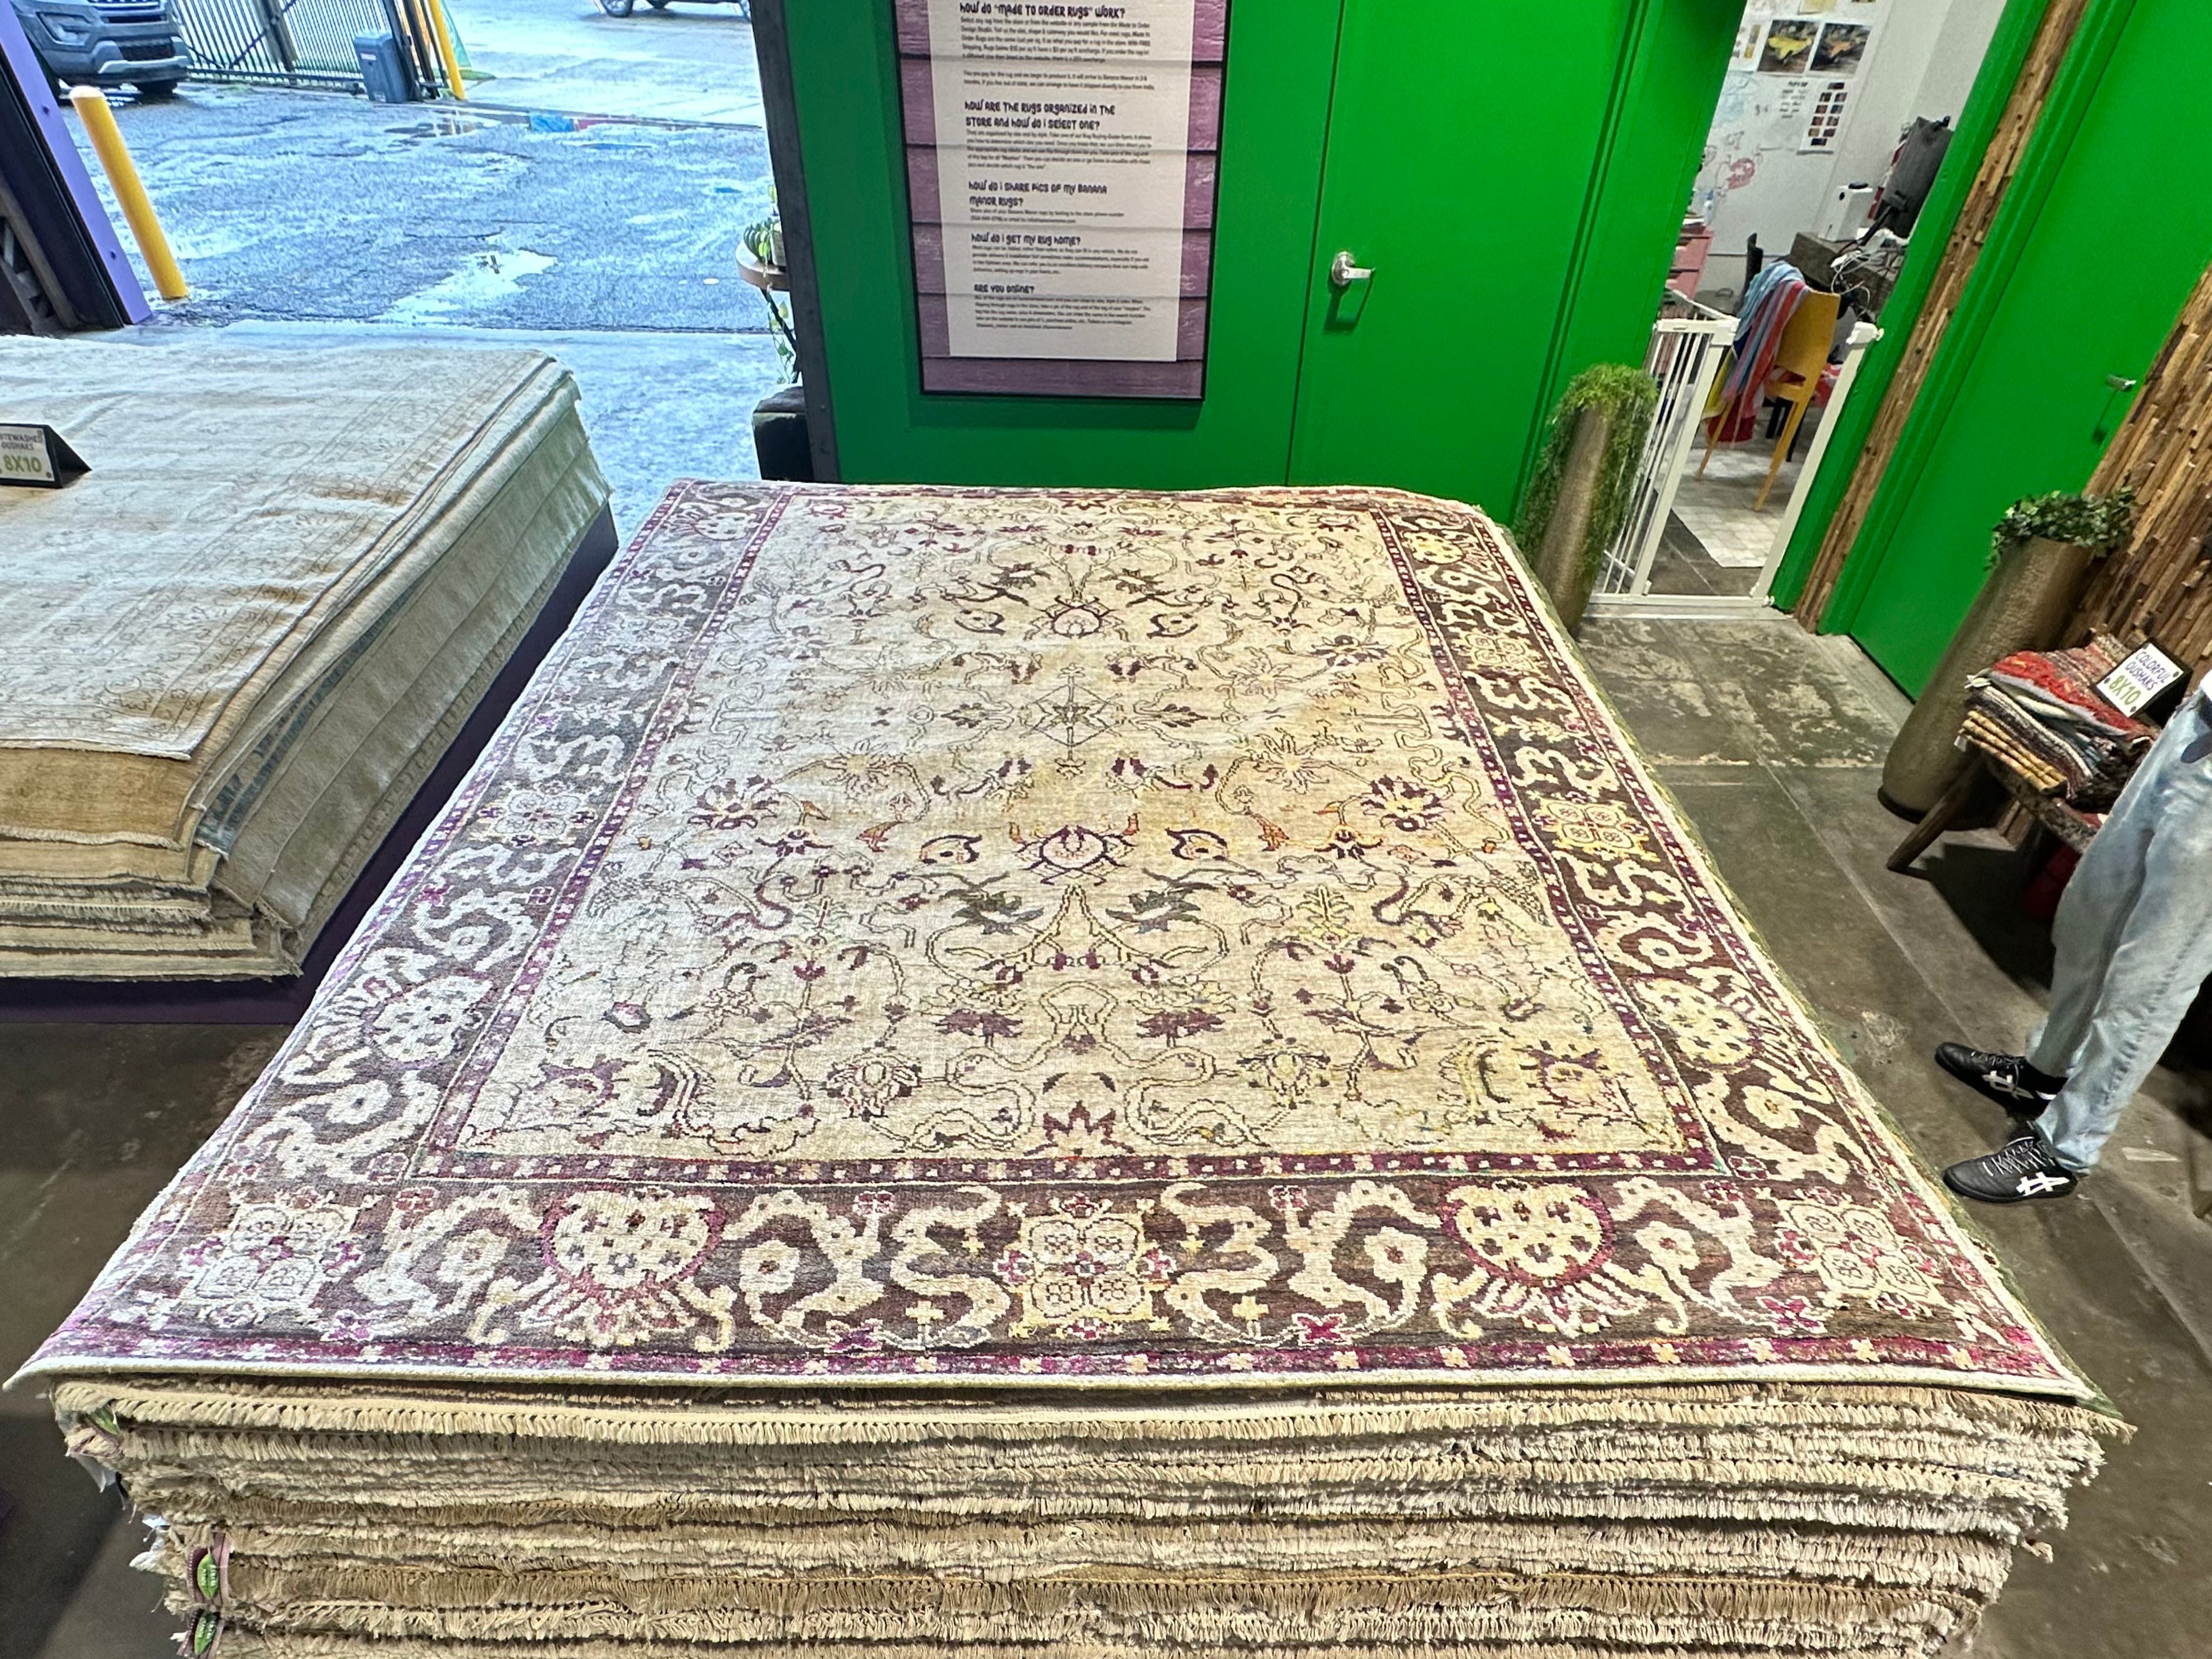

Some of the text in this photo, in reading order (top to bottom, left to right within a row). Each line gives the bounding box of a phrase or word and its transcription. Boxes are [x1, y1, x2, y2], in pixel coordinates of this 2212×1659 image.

[3, 454, 42, 473] 8X10
[2125, 661, 2159, 690] OUSHAKS
[2135, 651, 2171, 683] COLORFUL
[2109, 674, 2141, 705] 8X10
